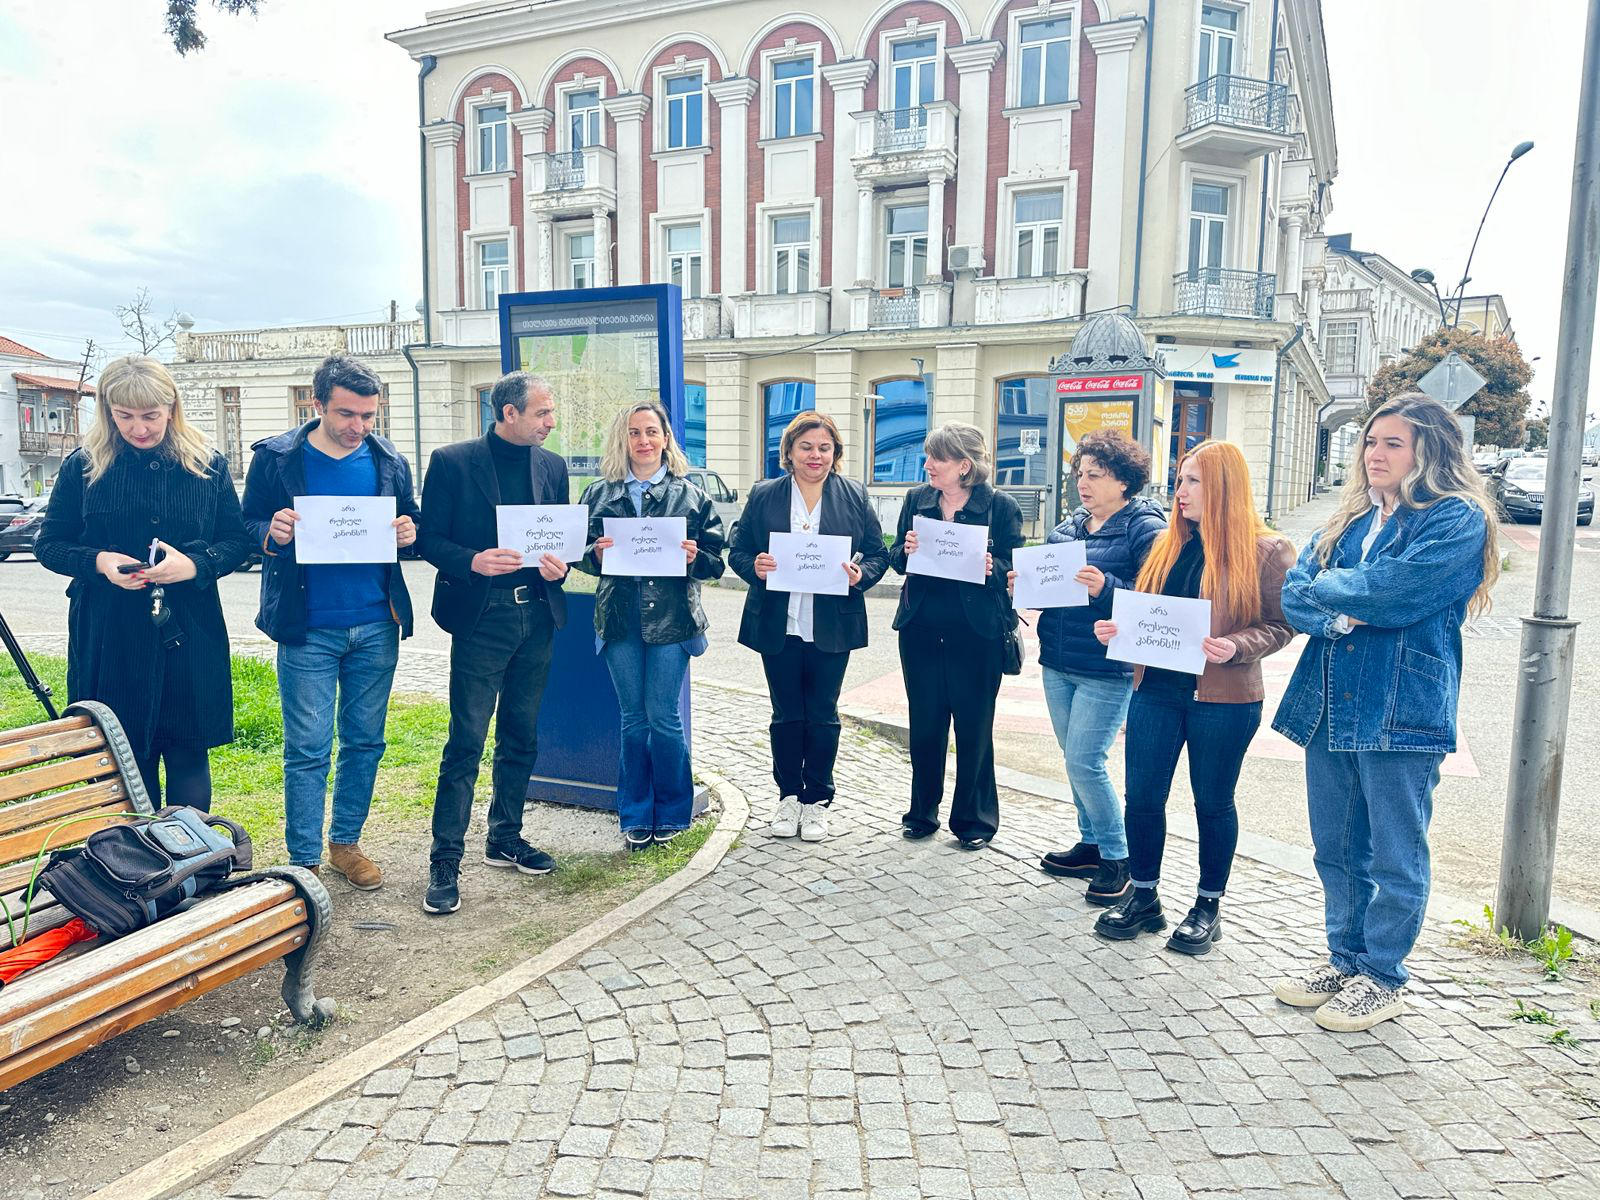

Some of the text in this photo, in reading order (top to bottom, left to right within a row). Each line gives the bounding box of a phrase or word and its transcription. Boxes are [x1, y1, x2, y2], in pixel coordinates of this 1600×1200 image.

[341, 504, 356, 513] არა
[329, 517, 362, 527] რუსულ
[536, 514, 553, 523] არა
[525, 529, 563, 540] რუსულ
[524, 542, 564, 554] კანონს!!!
[1150, 606, 1168, 616] არა
[1138, 620, 1180, 637] რუსულ
[1136, 636, 1181, 650] კანონს!!!
